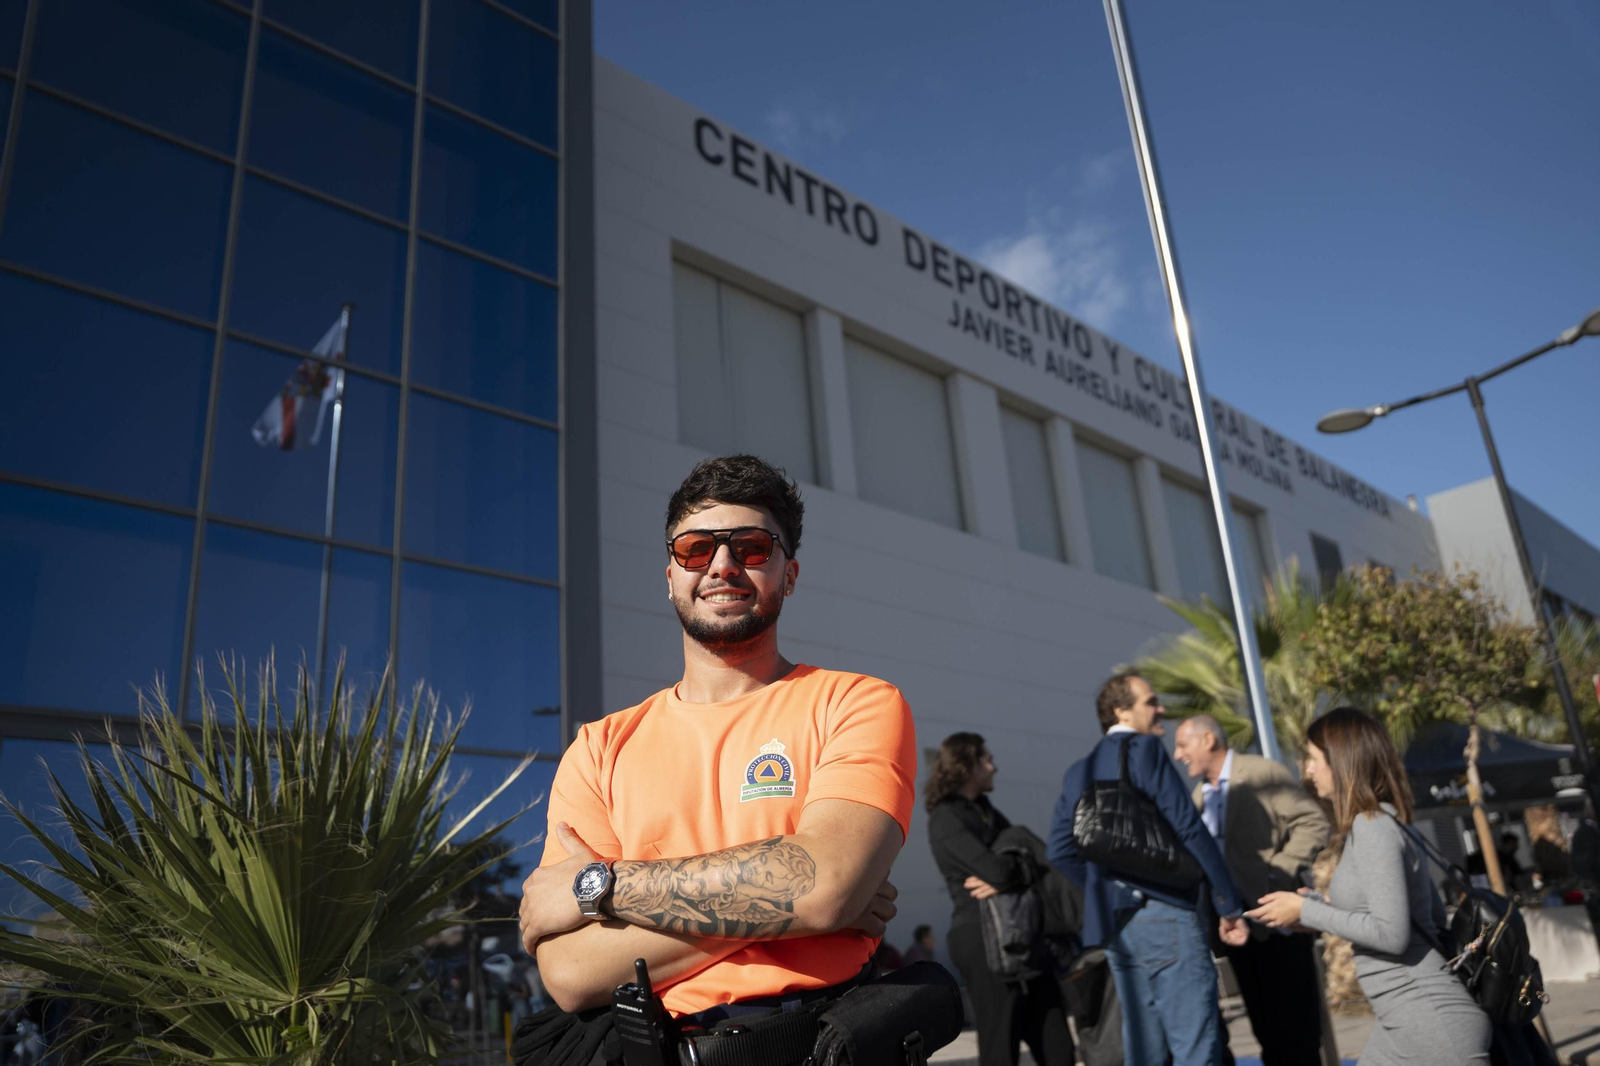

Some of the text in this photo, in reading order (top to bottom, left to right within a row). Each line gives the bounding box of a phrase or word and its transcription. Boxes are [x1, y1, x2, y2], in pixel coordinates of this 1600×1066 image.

[693, 116, 879, 246] CENTRO
[902, 225, 1093, 360] DEPORTIVO
[1102, 337, 1120, 376] Y
[1262, 426, 1290, 467] DE
[948, 301, 1037, 367] JAVIER
[1046, 350, 1163, 429] AURELIANO
[748, 754, 790, 778] PROTECCIÓN CIVIL
[616, 1003, 643, 1013] MOTOROLA
